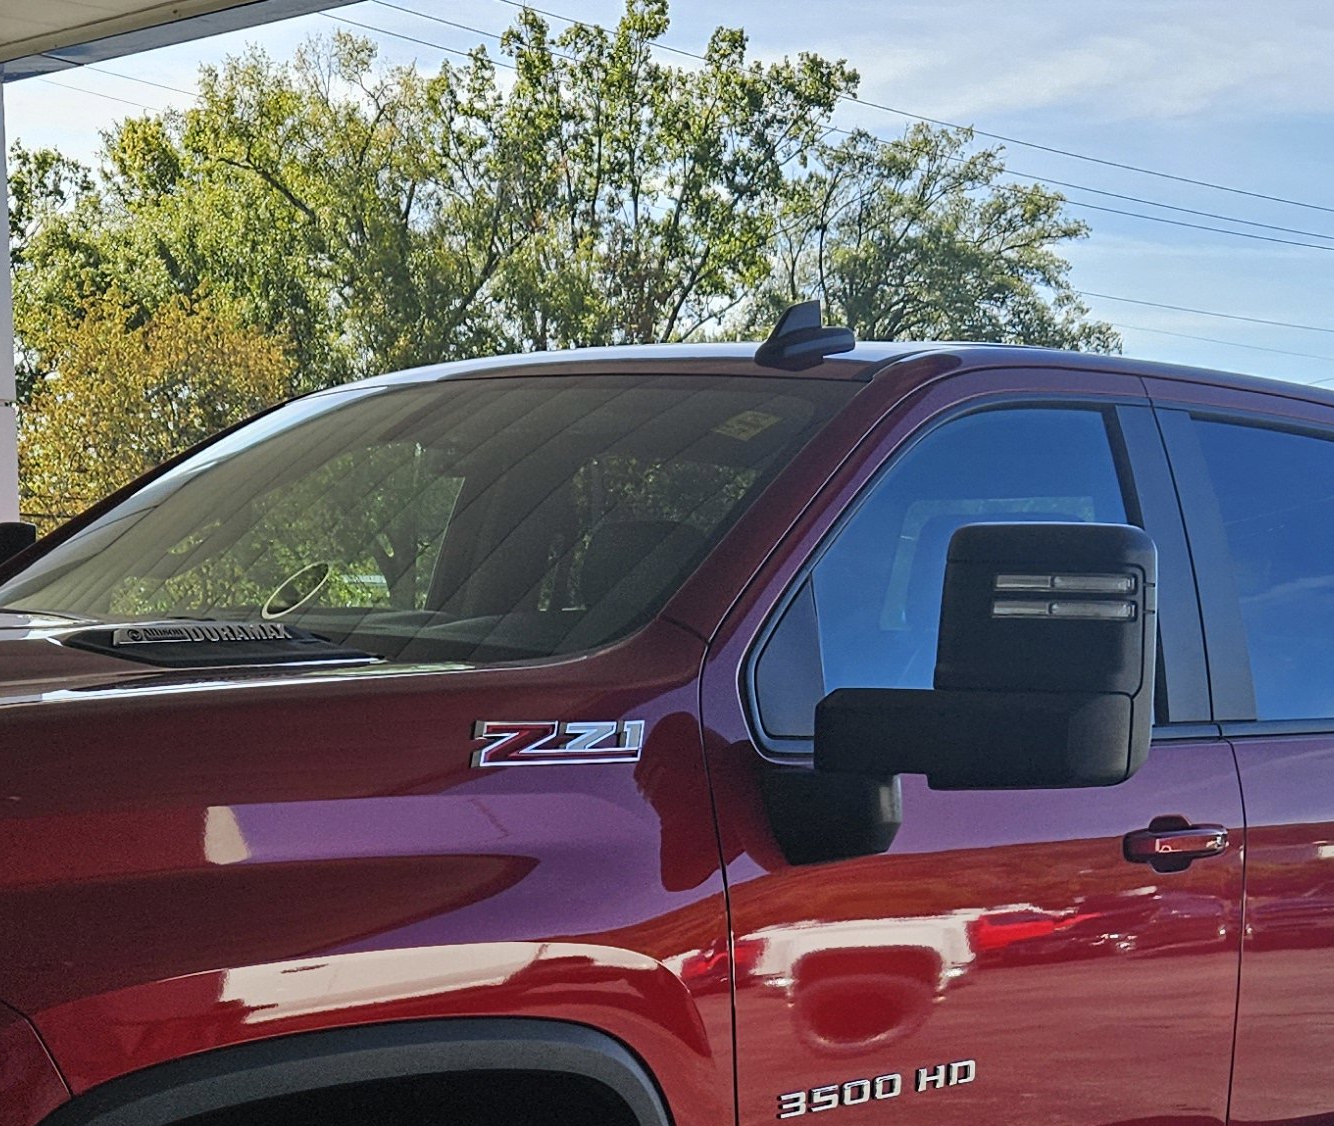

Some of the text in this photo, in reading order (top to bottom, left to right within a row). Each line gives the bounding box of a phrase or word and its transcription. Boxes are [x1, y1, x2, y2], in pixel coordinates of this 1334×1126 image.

[185, 623, 293, 642] DURAMAX
[470, 719, 645, 768] Z71
[777, 1059, 976, 1119] 3500 HD
